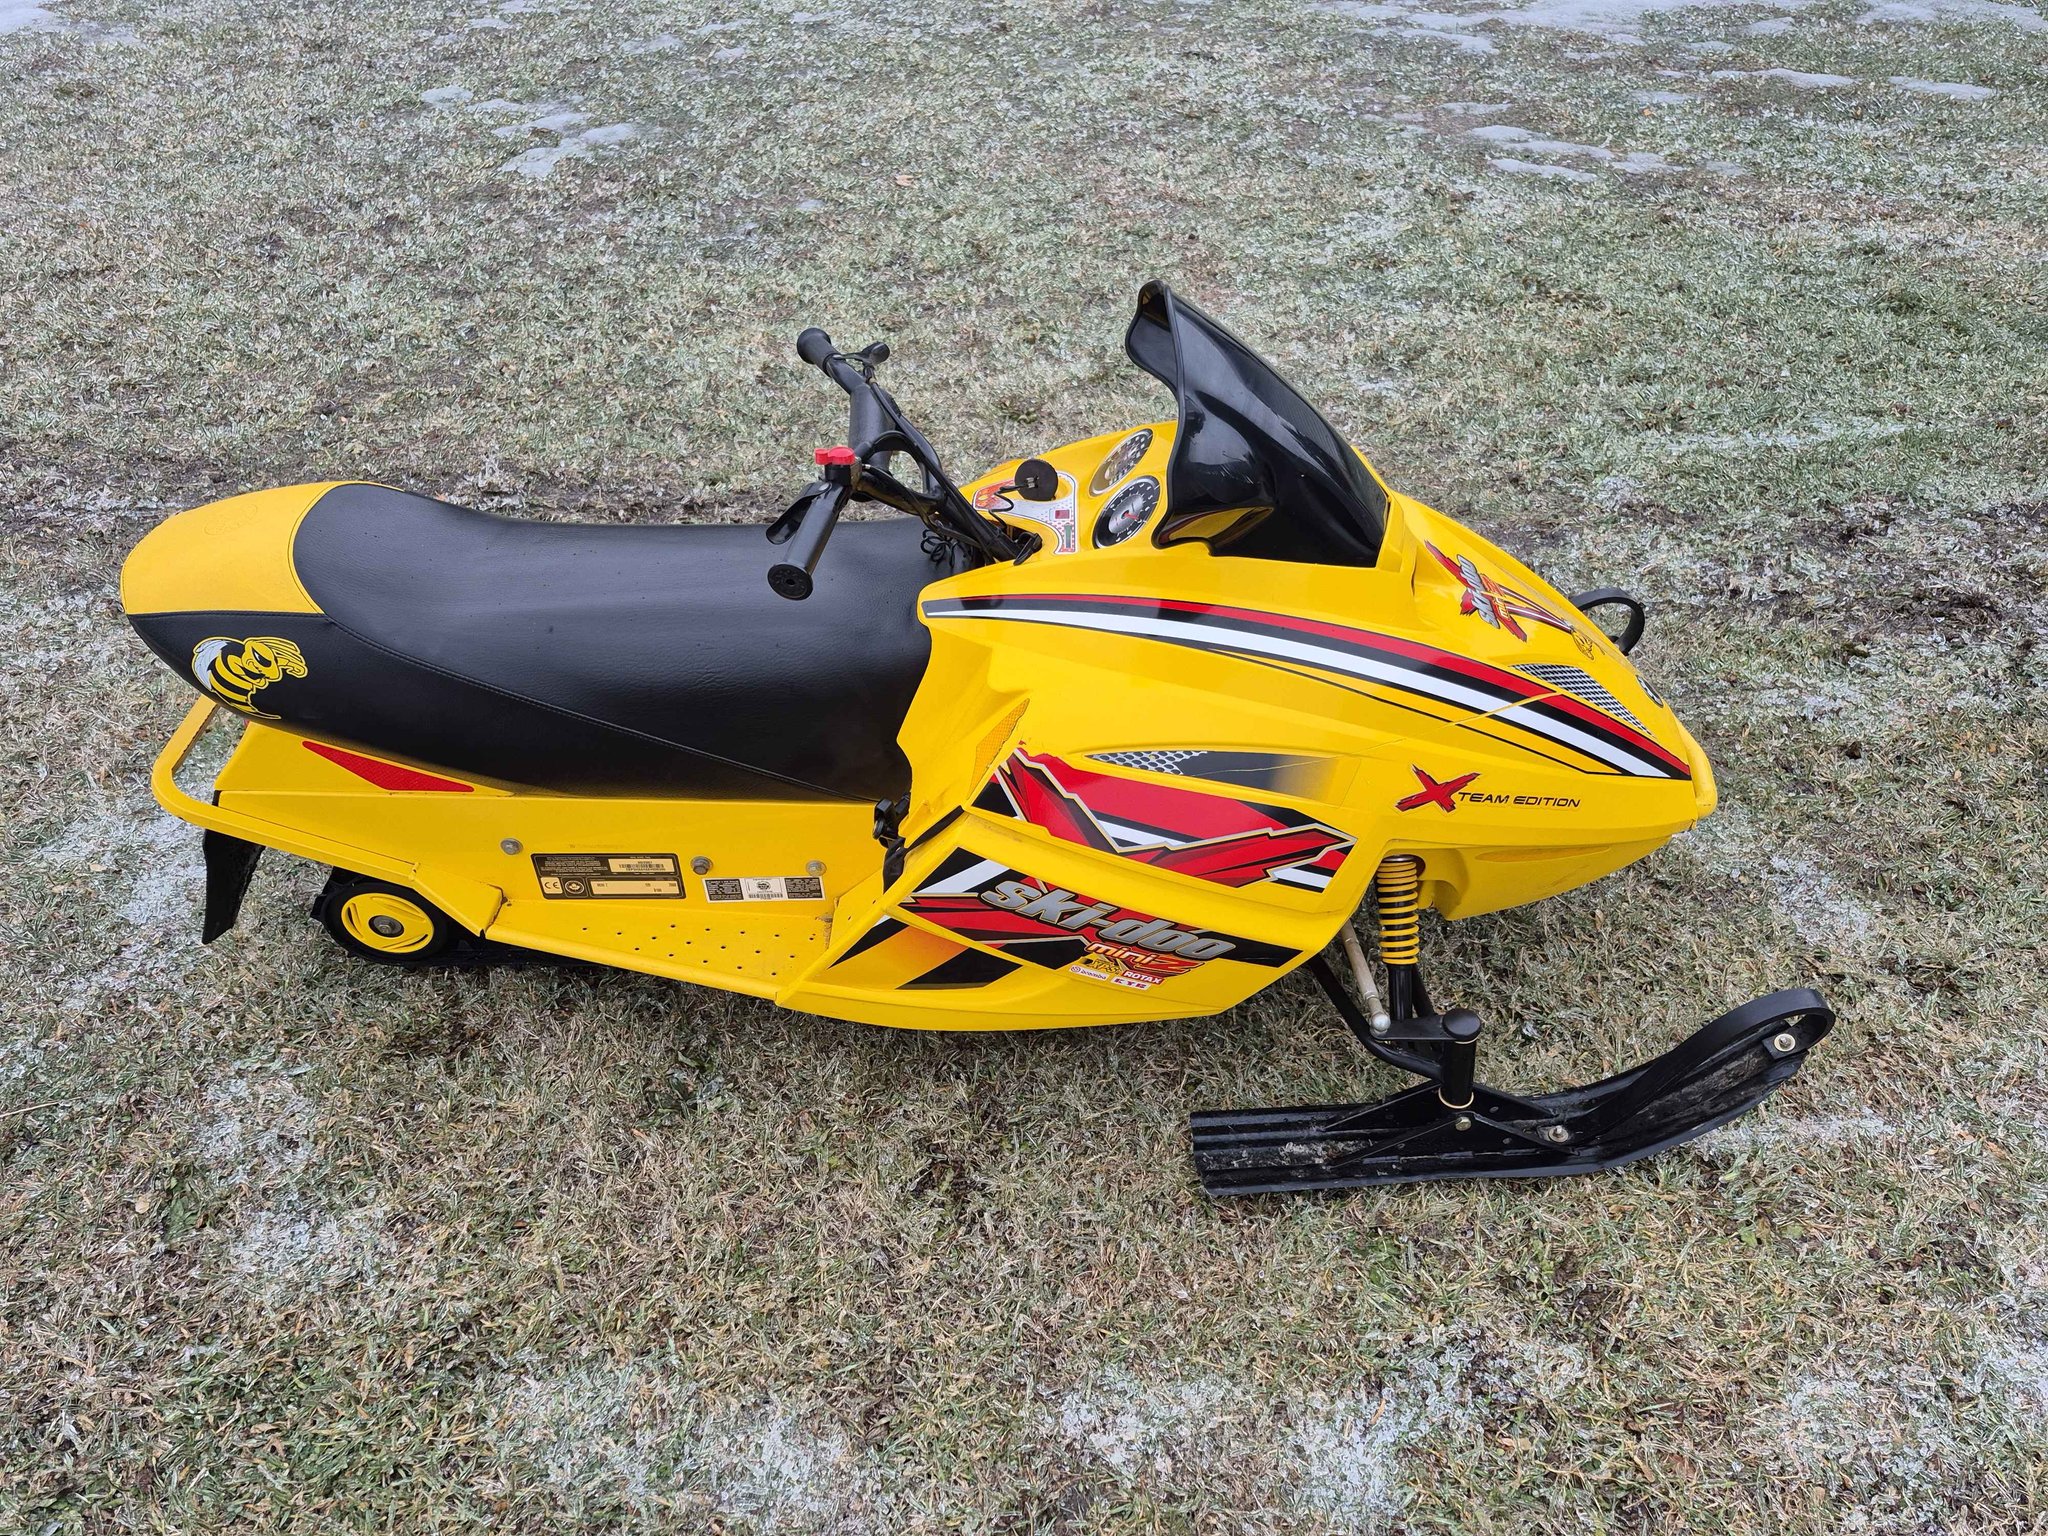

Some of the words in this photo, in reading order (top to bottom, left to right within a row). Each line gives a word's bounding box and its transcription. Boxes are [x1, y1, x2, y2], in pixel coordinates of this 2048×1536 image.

[1458, 791, 1510, 804] TEAM
[1513, 795, 1581, 808] EDITION
[1123, 970, 1164, 984] ROTAX
